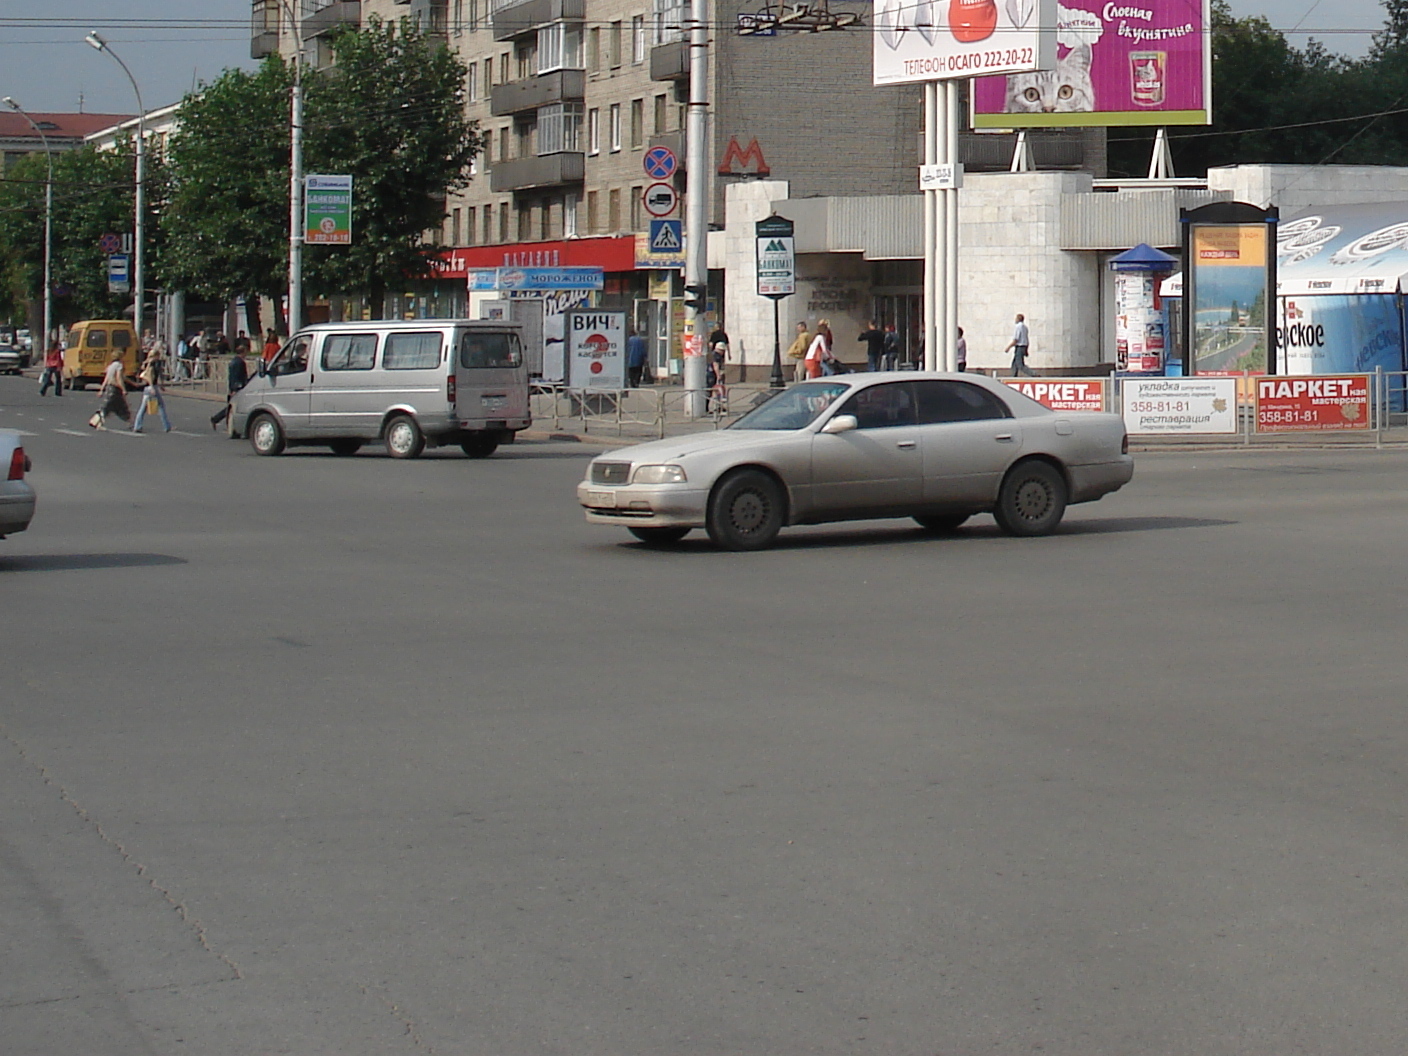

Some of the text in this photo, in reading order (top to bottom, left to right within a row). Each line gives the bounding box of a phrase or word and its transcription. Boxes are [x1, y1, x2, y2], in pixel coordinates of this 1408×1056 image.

[1103, 2, 1153, 22] Слоеная
[1118, 20, 1194, 44] вкуснятина
[904, 48, 1033, 75] ТЕЛЕФОН ОСАГО 222-20-22
[531, 274, 599, 283] МОРОЖЕНОЕ
[1275, 322, 1325, 349] евское
[1138, 382, 1180, 392] укладка
[1051, 401, 1101, 410] мастерская
[1131, 401, 1190, 413] 358-81-81
[1312, 397, 1367, 406] мастерская
[1140, 415, 1211, 426] реставрация
[1260, 410, 1318, 423] 358-81-81
